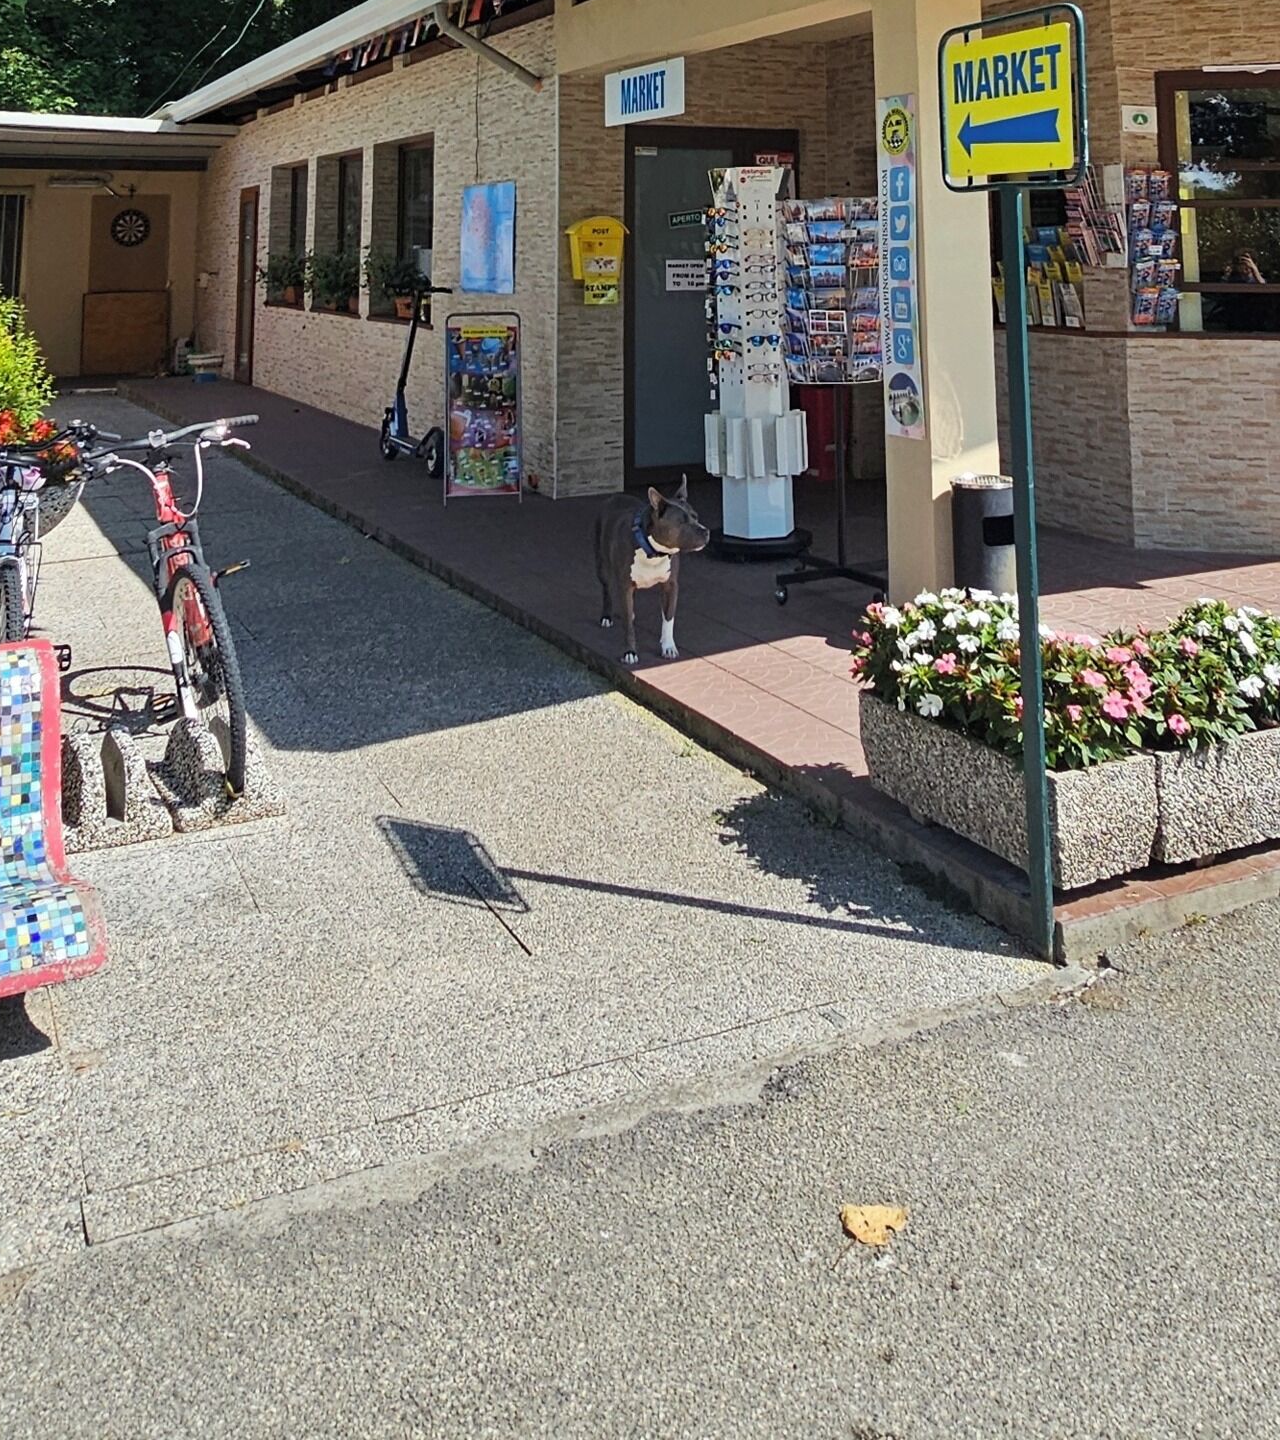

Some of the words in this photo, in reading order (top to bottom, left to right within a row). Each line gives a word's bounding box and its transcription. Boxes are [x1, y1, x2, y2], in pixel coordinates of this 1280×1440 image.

[621, 70, 666, 115] MARKET
[953, 44, 1061, 104] MARKET
[672, 213, 701, 224] APERTO
